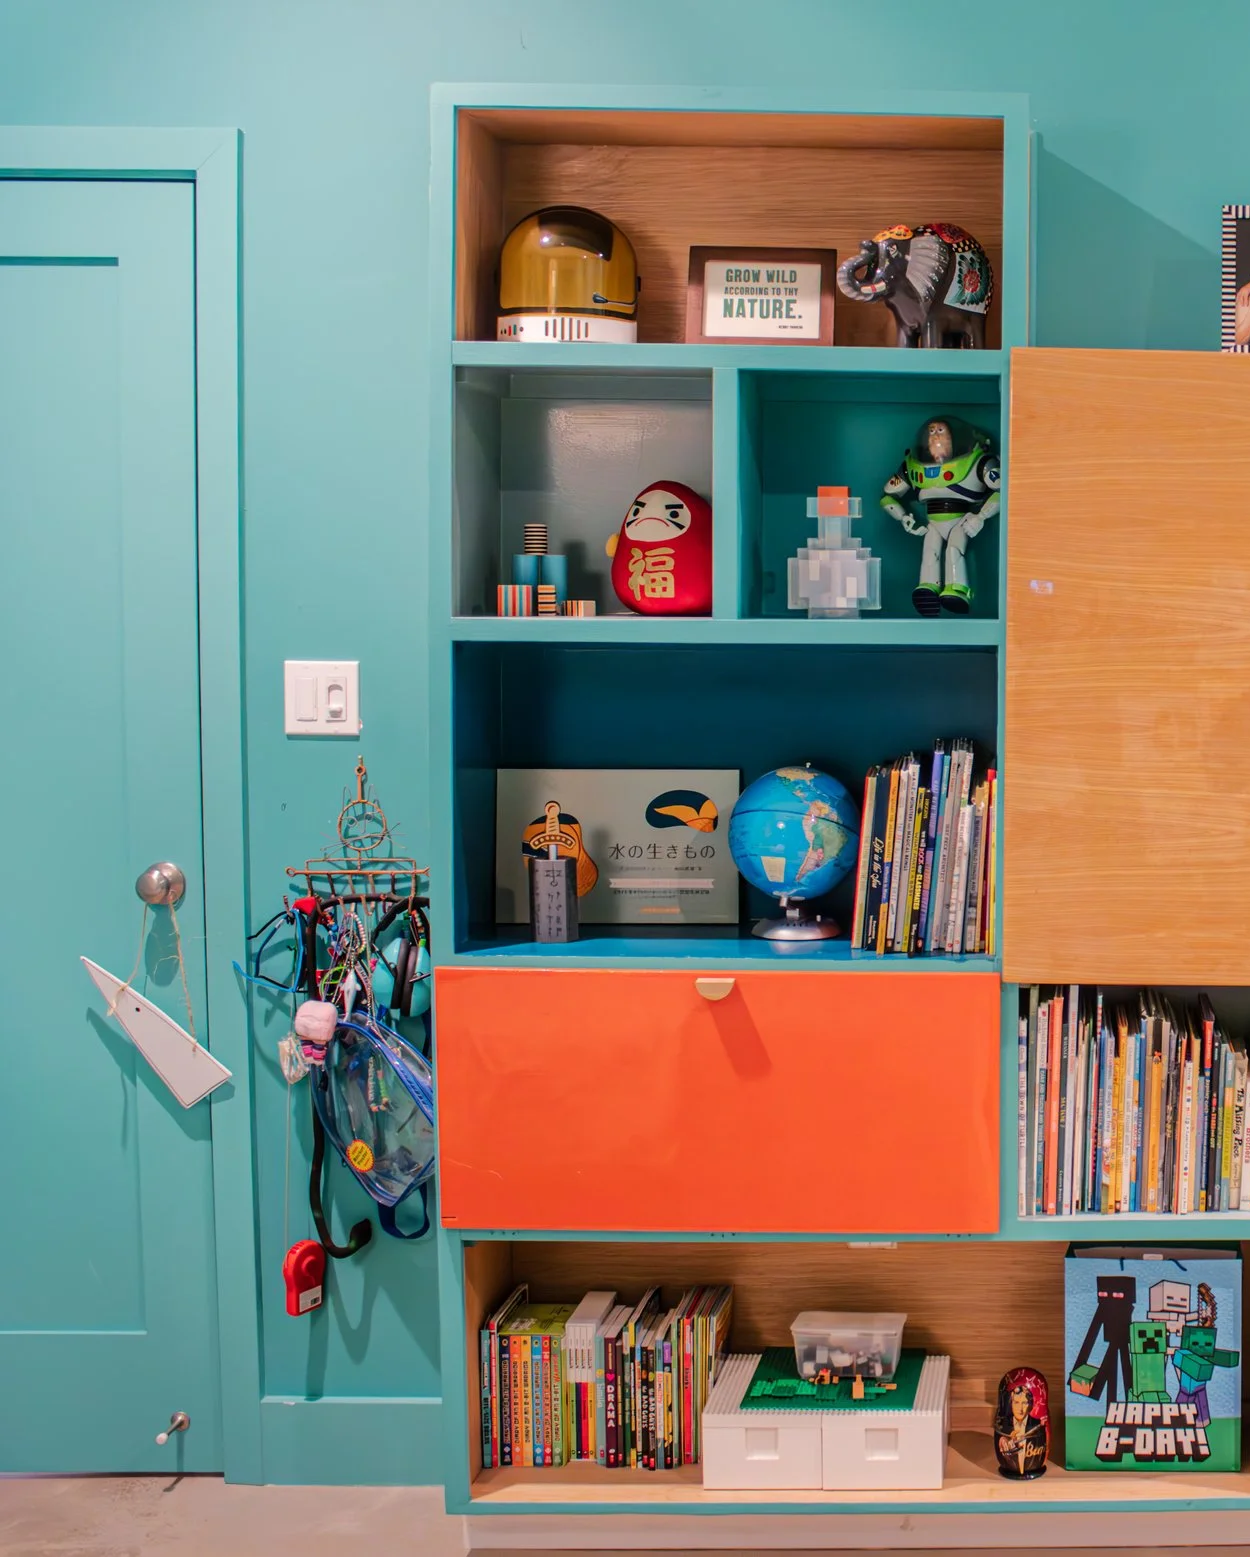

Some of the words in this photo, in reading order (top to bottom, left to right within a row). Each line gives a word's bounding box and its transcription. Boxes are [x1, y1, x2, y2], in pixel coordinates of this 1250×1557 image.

[725, 268, 761, 283] GROW
[766, 269, 797, 283] WILD
[723, 286, 769, 296] ACCORDING
[771, 287, 782, 296] TO
[783, 287, 799, 296] THY
[723, 298, 803, 319] NATURE.
[627, 546, 677, 603] 福
[873, 836, 884, 853] Life
[921, 831, 926, 839] we
[608, 842, 716, 860] 水の生きもの
[873, 853, 880, 861] in
[912, 874, 922, 911] CLASSMATES
[1236, 1088, 1245, 1103] The
[1233, 1104, 1244, 1135] Missing
[1233, 1137, 1243, 1159] Piece
[607, 1384, 615, 1428] DRAMA
[1105, 1402, 1198, 1425] HAPPY
[1094, 1427, 1210, 1457] B-DAY!
